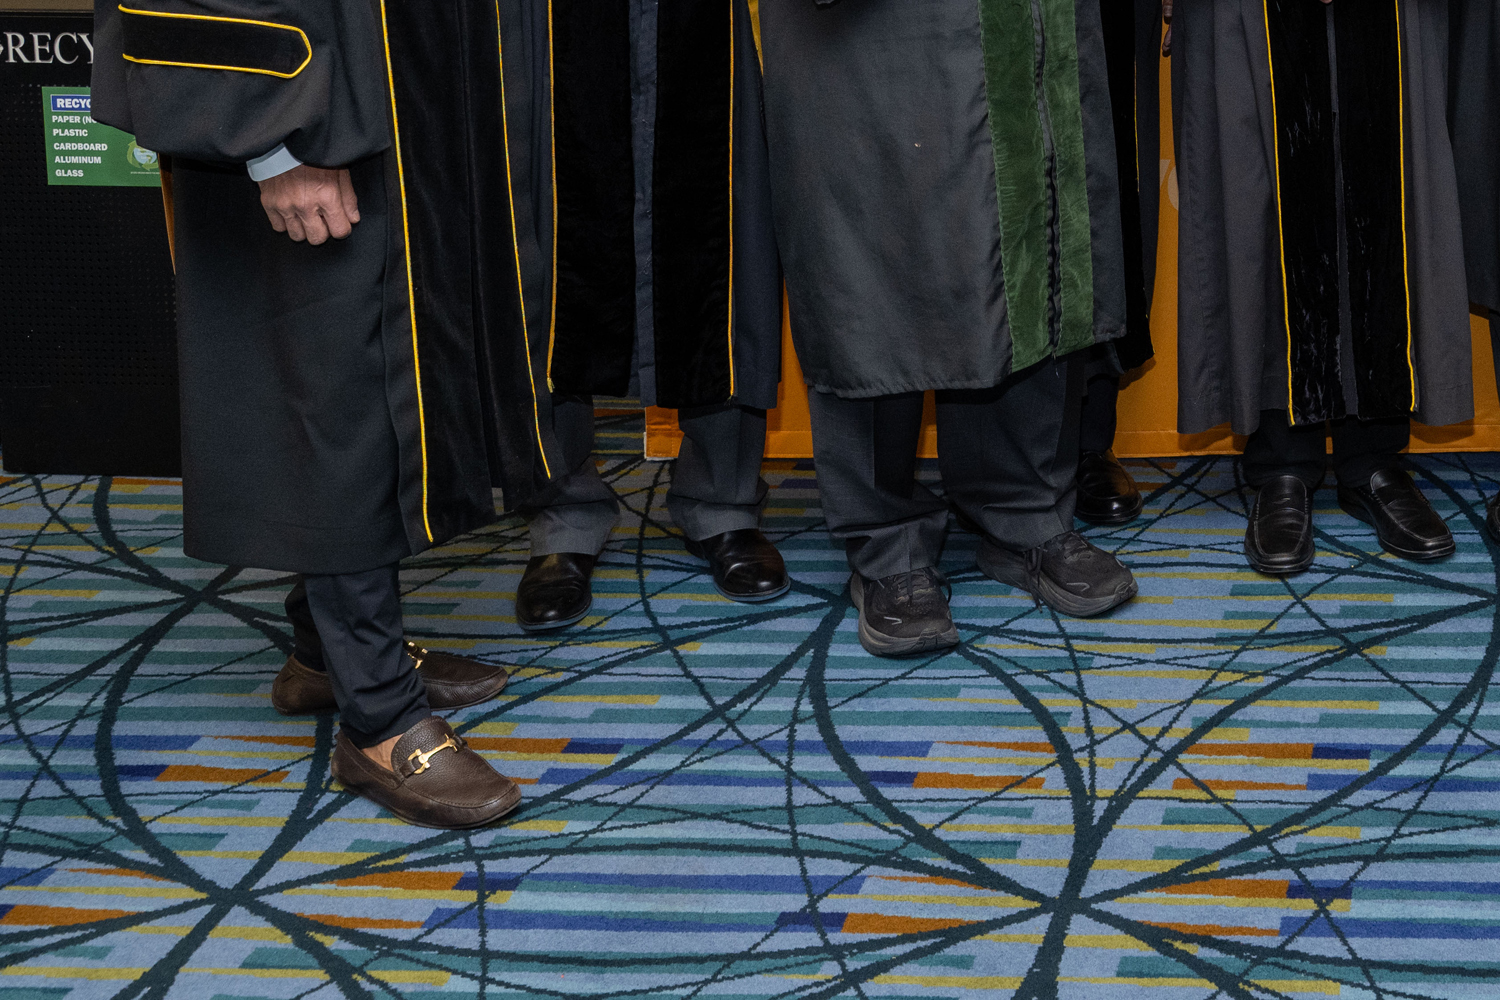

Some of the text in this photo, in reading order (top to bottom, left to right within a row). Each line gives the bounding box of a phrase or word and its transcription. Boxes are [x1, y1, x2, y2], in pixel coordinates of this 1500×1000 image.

[3, 31, 94, 65] RECY
[56, 98, 91, 109] RECYC
[52, 115, 81, 123] PAPER
[52, 129, 88, 137] PLASTIC
[54, 142, 108, 151] CARDBOARD
[55, 156, 101, 164] ALUMINUM
[55, 169, 84, 177] GLASS
